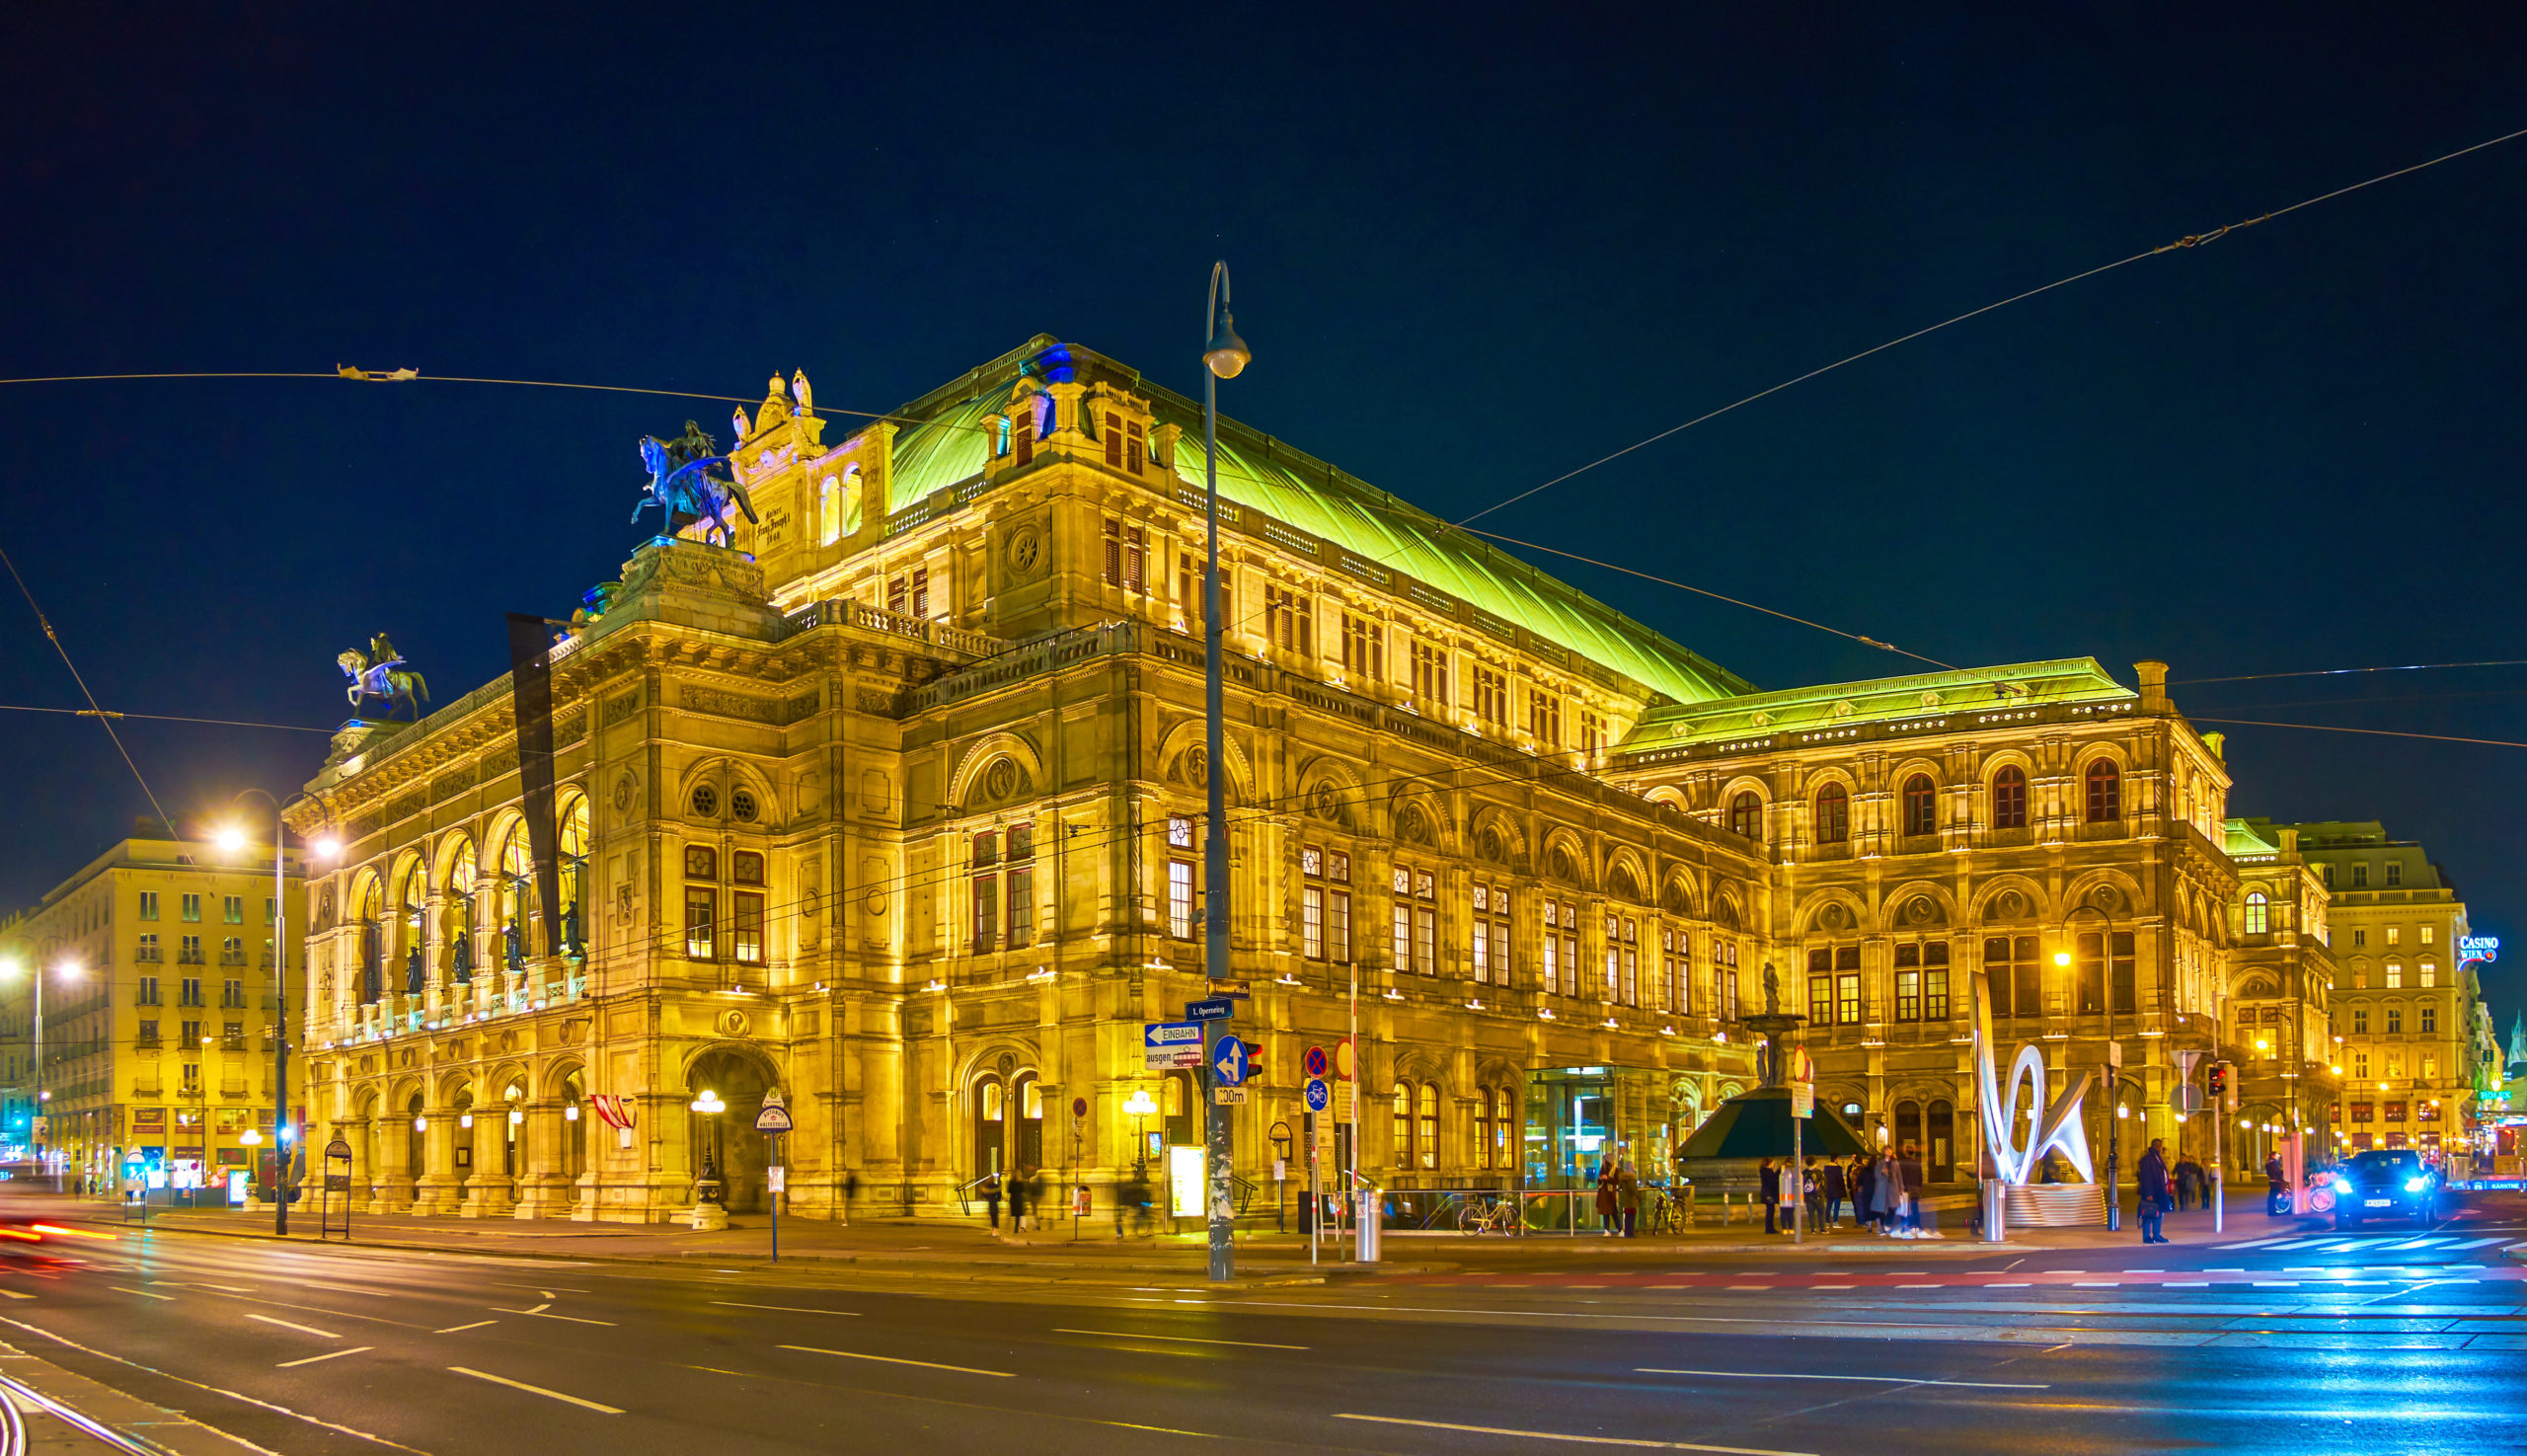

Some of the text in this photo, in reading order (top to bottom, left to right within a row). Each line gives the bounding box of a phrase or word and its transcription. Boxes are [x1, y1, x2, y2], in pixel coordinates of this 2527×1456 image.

[2460, 936, 2498, 949] CASINO
[2460, 950, 2484, 958] WIEN
[1163, 1028, 1196, 1039] EINBAHN
[1220, 1089, 1244, 1103] 00m
